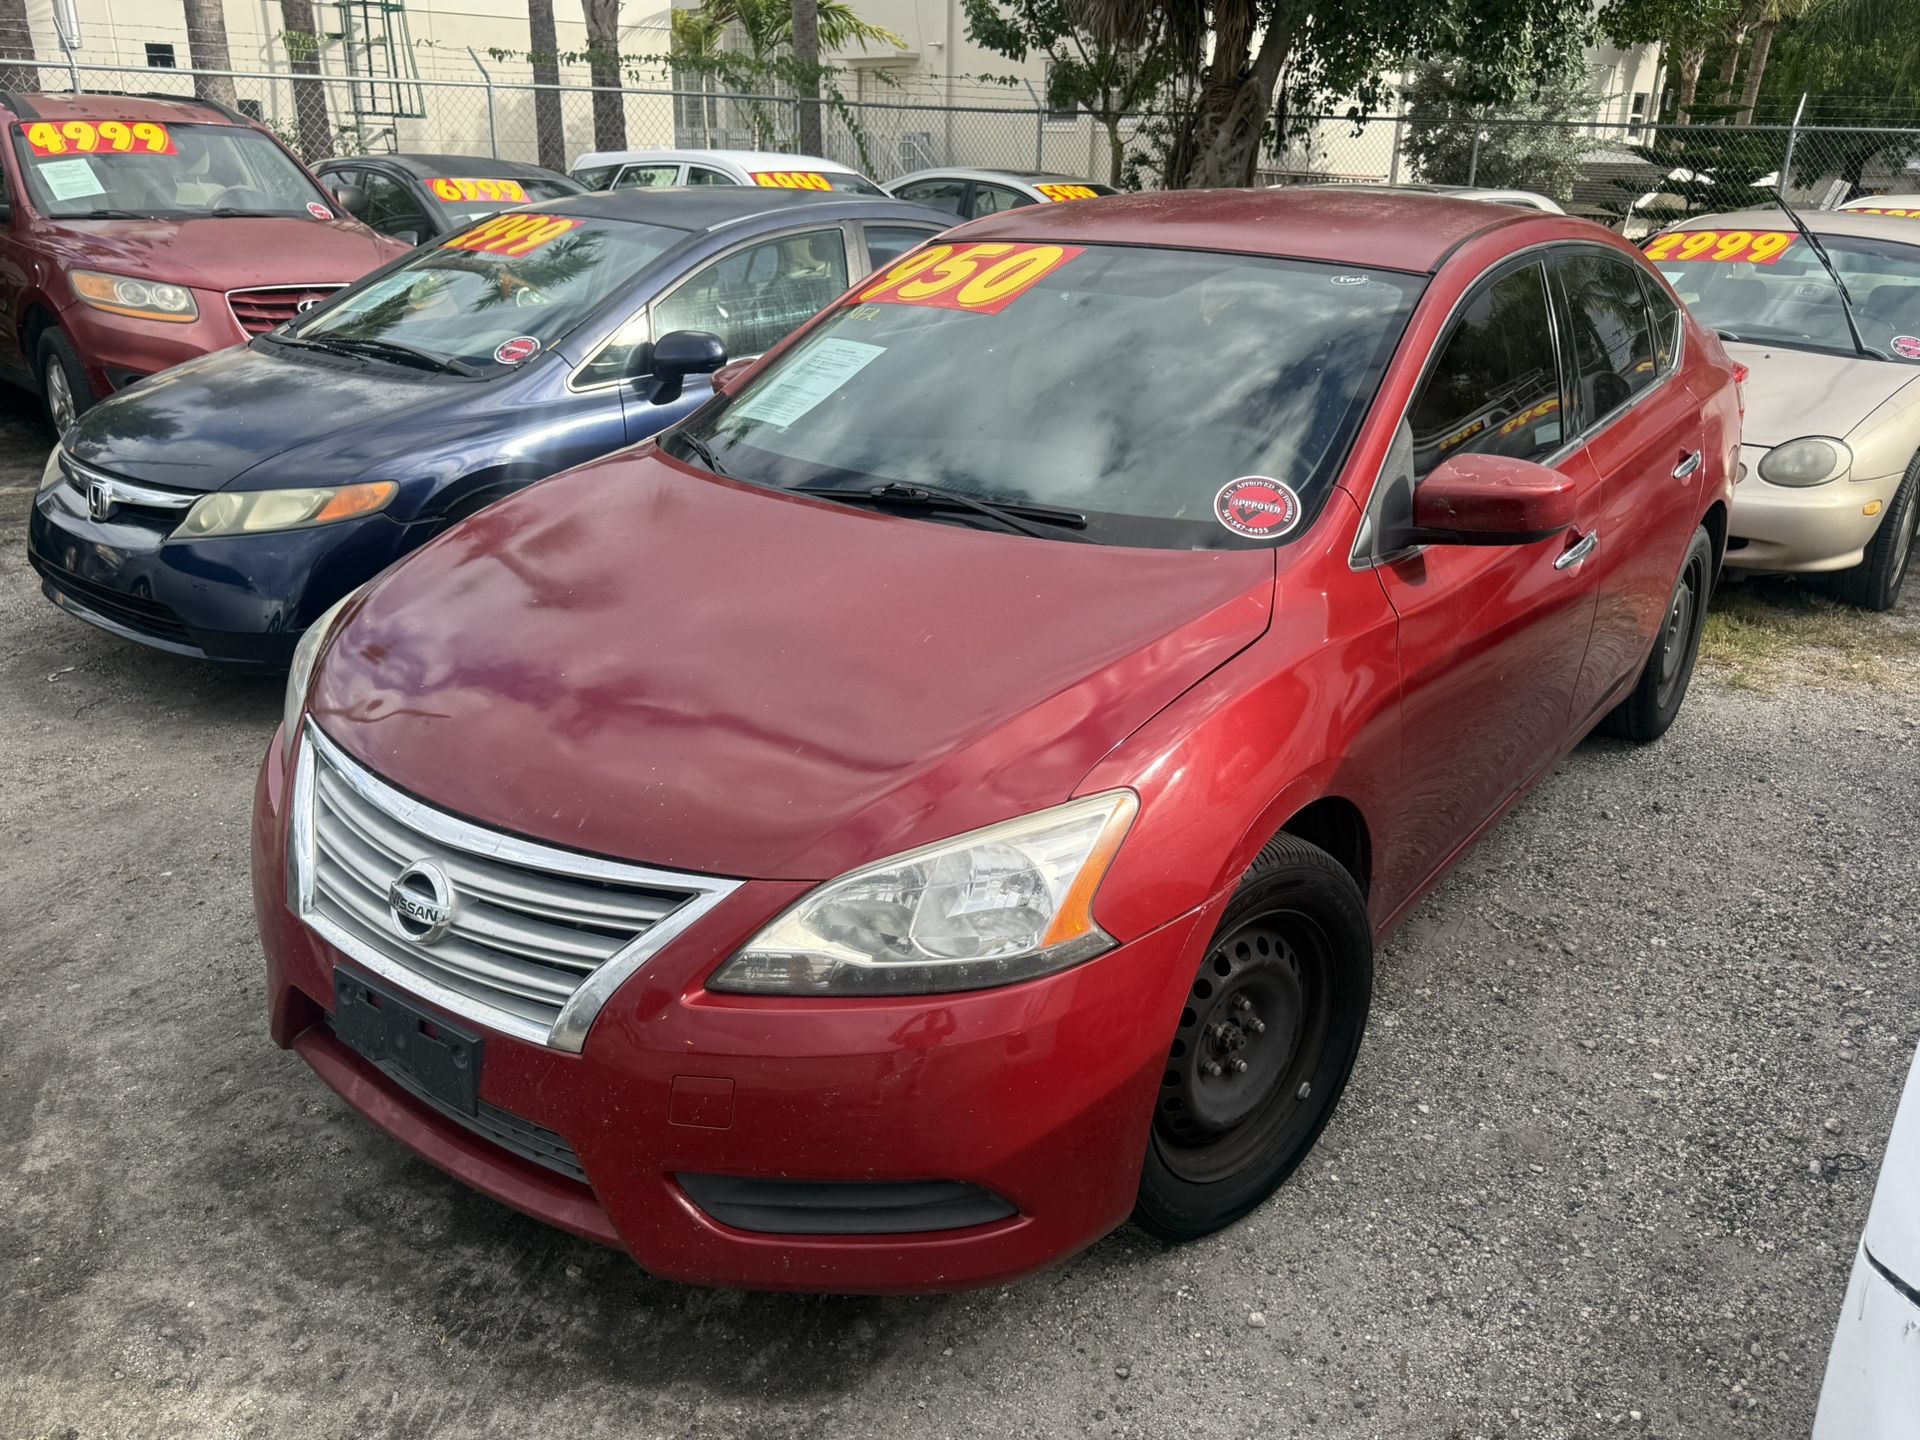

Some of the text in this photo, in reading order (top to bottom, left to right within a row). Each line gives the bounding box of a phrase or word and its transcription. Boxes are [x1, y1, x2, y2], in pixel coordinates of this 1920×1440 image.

[28, 121, 169, 154] 4999
[433, 179, 524, 201] 6999
[1646, 231, 1792, 263] 2999
[1223, 488, 1237, 500] ALL
[1236, 480, 1276, 490] APPROVED
[1232, 498, 1283, 514] APPROVED
[390, 888, 439, 922] NISSAN
